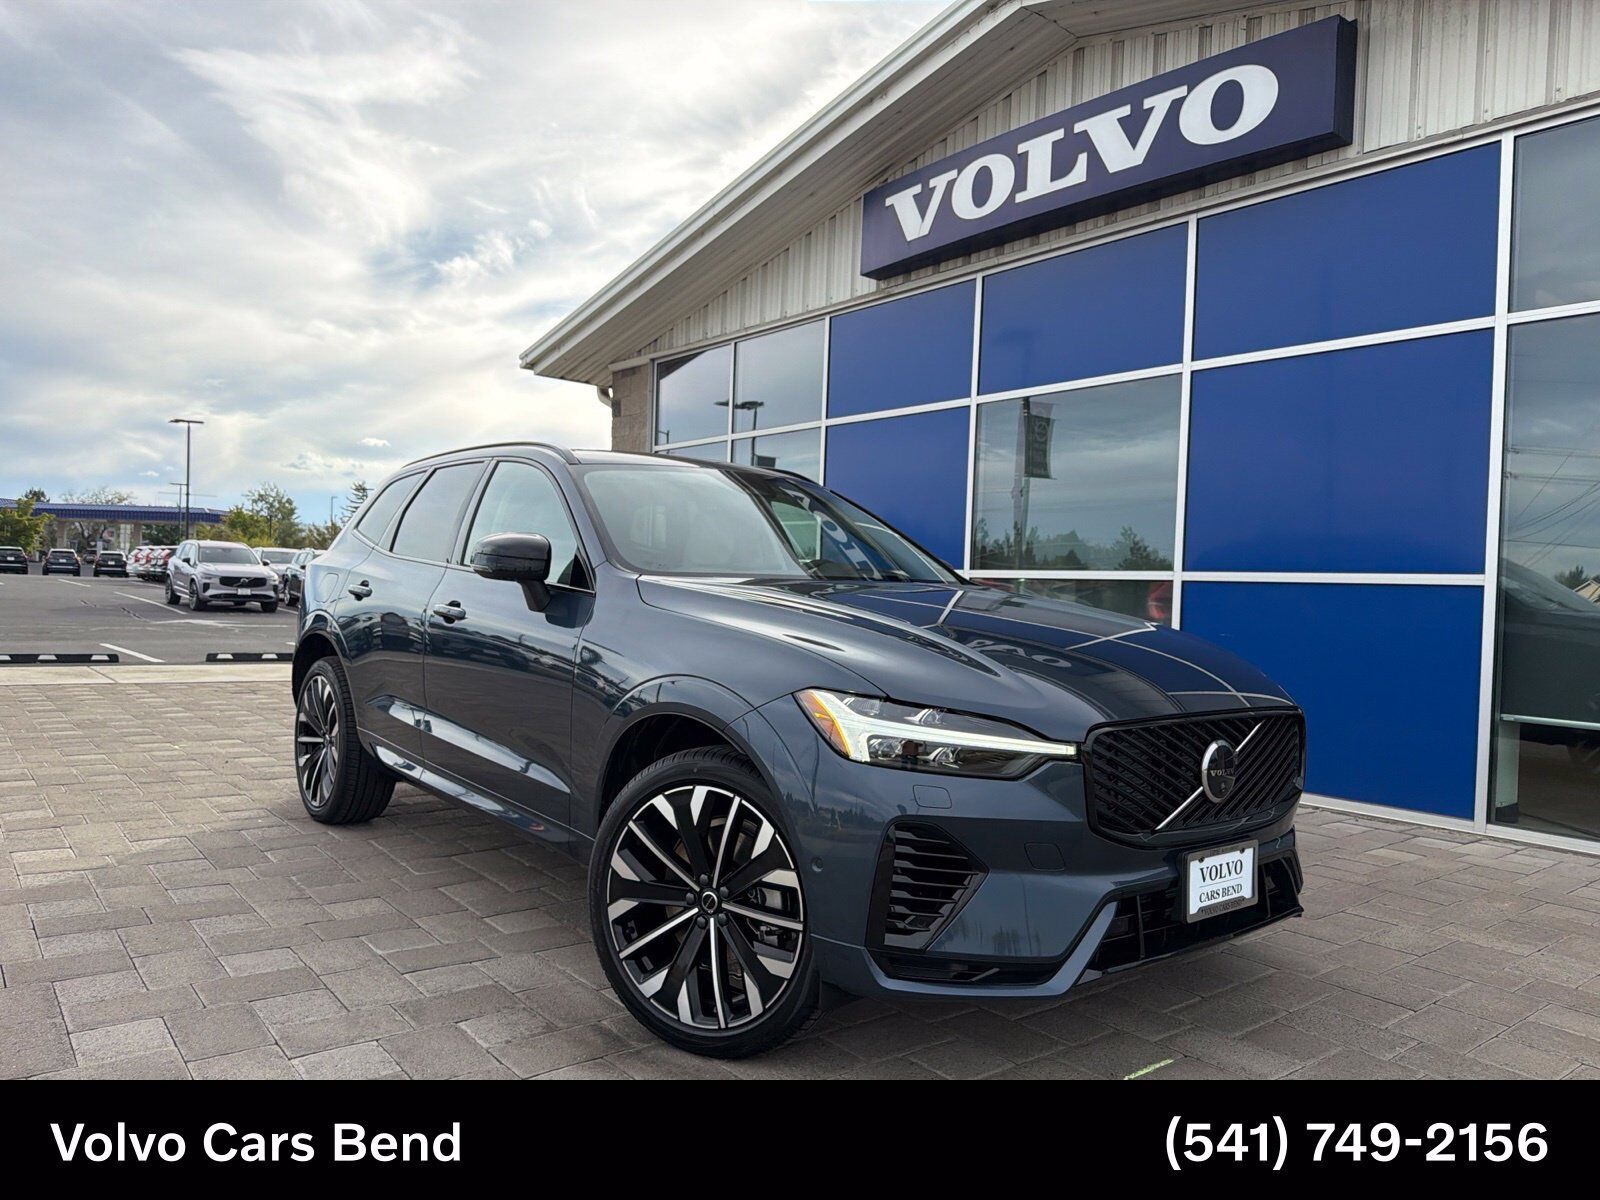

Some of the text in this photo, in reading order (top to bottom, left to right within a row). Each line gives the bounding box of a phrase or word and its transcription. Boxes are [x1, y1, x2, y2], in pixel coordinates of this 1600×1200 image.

[885, 64, 1279, 242] VOLVO
[1199, 859, 1243, 883] VOLVO
[1199, 883, 1243, 903] CARS BEND
